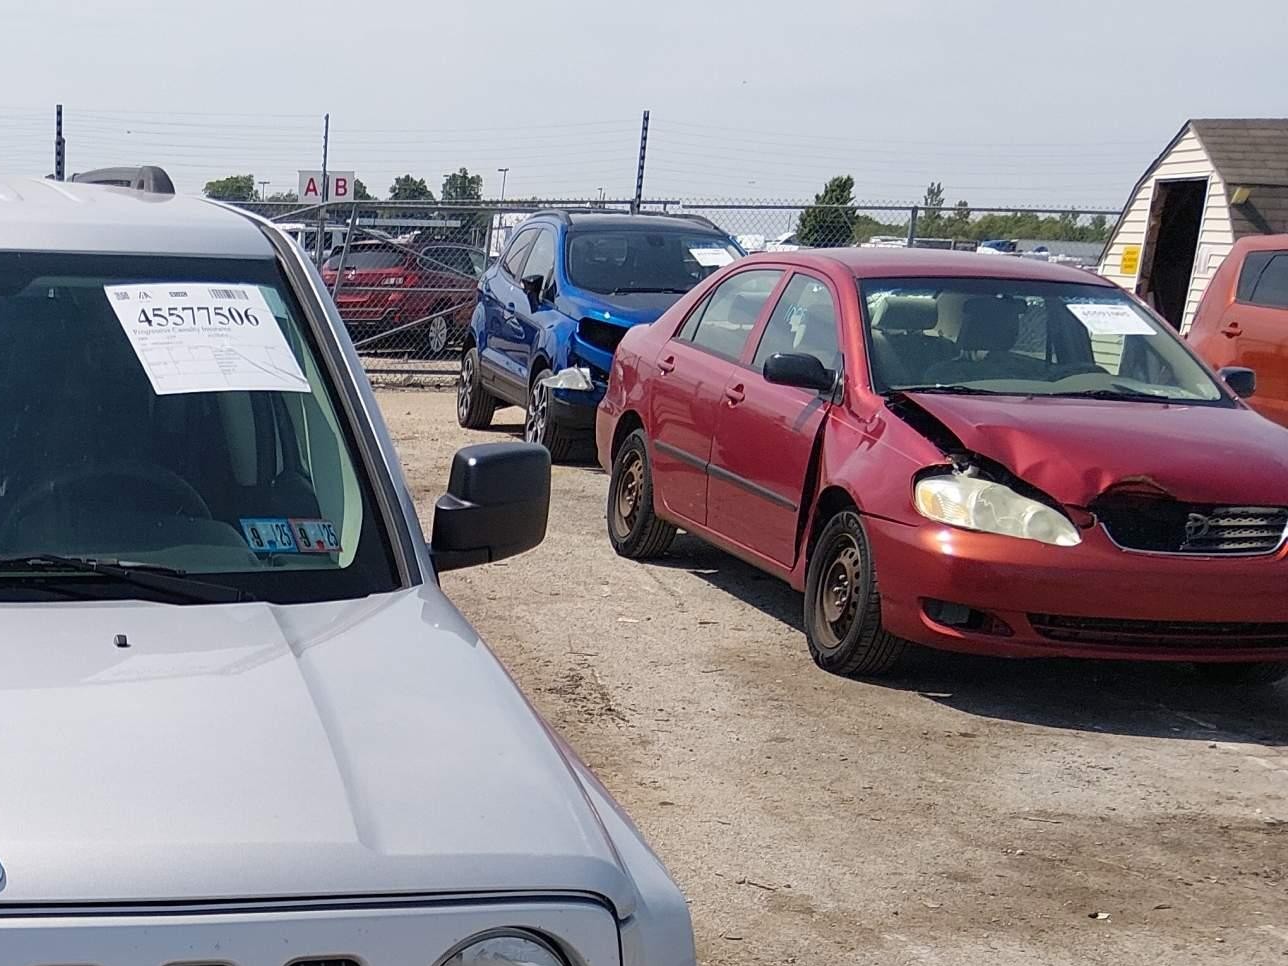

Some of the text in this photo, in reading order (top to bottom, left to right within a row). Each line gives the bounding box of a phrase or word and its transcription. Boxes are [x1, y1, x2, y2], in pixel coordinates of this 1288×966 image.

[304, 177, 347, 196] A B
[138, 306, 260, 328] 45577506
[250, 527, 263, 547] 9
[298, 527, 311, 547] 9
